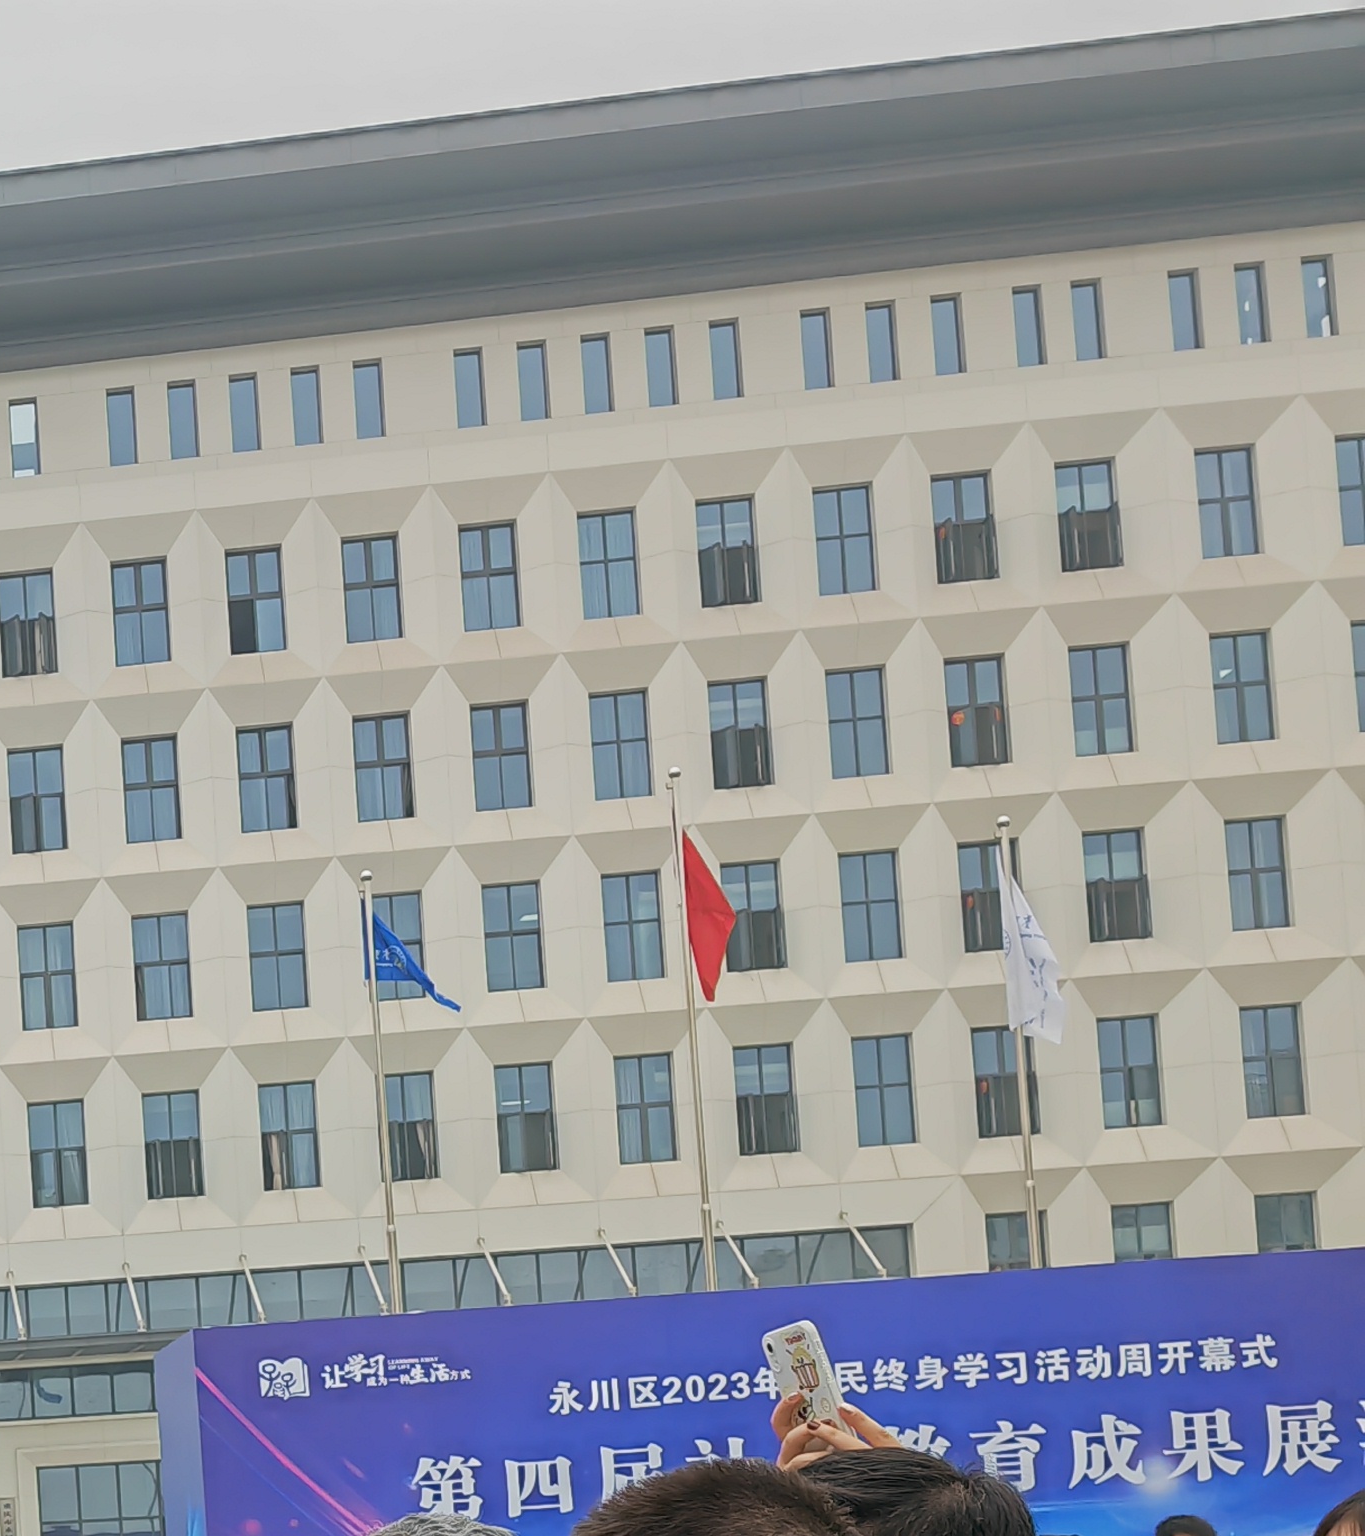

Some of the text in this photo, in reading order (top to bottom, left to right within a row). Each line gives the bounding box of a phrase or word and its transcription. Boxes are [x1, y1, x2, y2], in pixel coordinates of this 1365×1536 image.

[548, 1333, 1279, 1416] 永川区2023年民终身学习活动周开幕式
